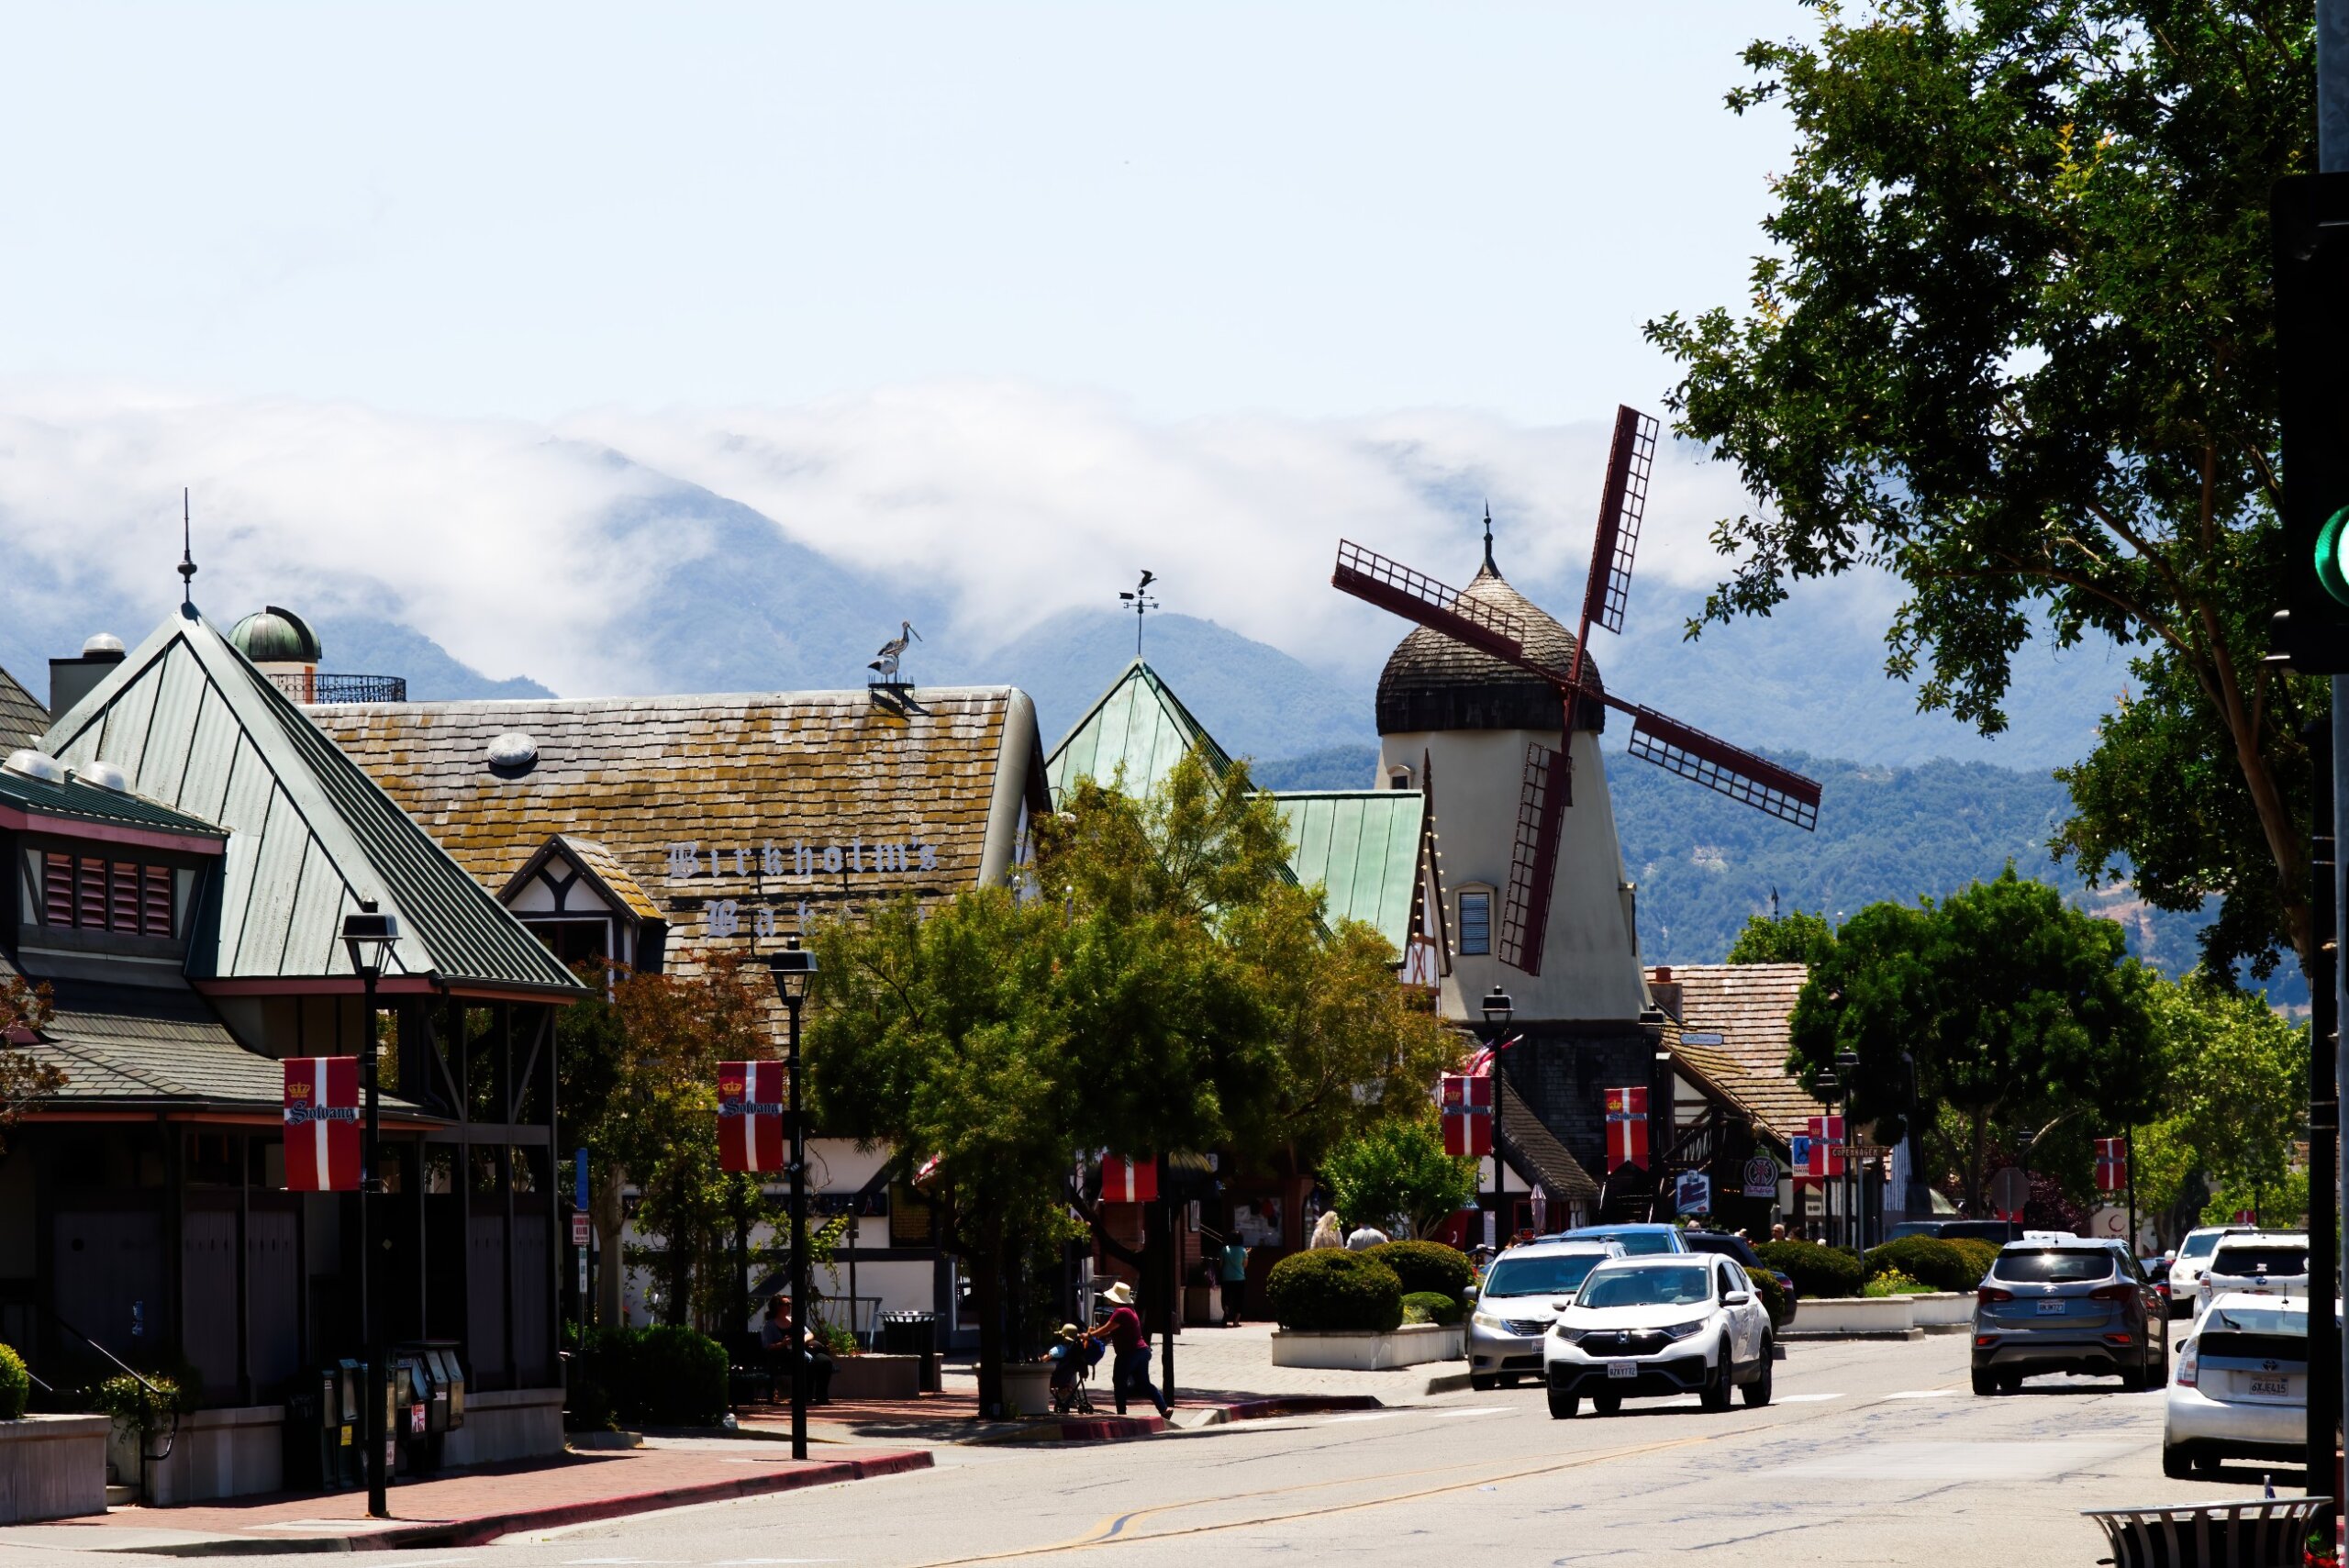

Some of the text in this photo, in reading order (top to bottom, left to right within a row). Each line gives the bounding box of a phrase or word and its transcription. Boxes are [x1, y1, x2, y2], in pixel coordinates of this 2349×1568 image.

[662, 836, 939, 878] Birkholm's
[288, 1101, 356, 1125] Solvang
[721, 1097, 780, 1118] Solvang
[1832, 1148, 1878, 1157] COPENHAGEN
[2251, 1382, 2287, 1394] 6XJE415
